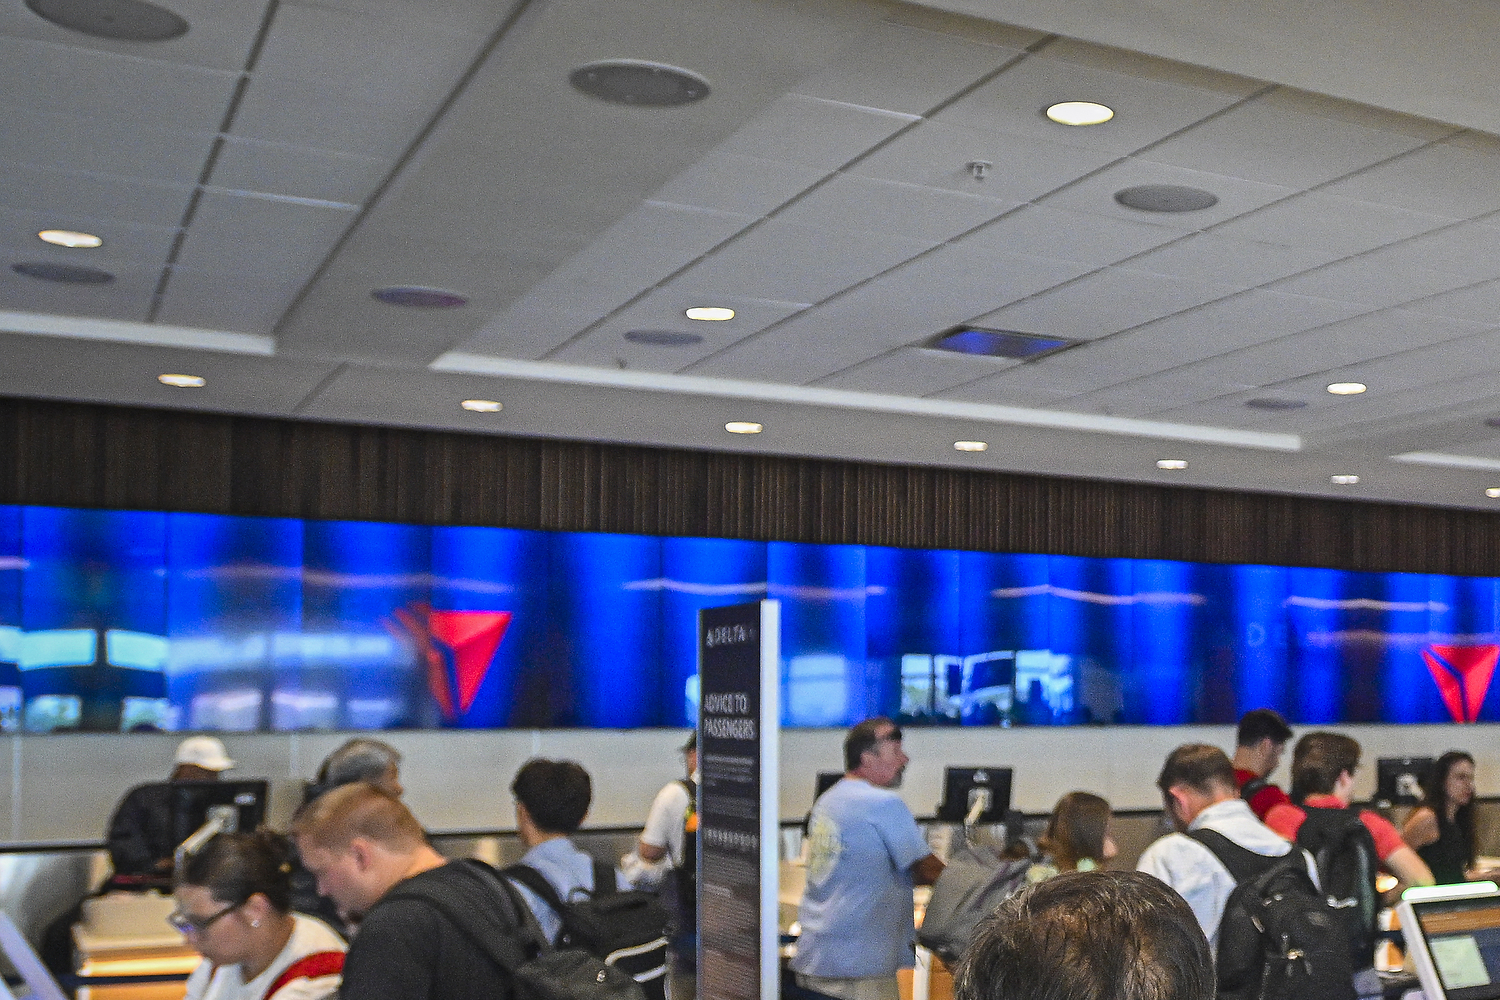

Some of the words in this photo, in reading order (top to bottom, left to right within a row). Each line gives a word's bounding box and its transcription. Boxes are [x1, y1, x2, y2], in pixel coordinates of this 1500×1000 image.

[714, 624, 746, 645] DELTA
[704, 693, 733, 714] ADVICE
[735, 693, 749, 714] TO
[704, 718, 755, 740] PASSENGERS
